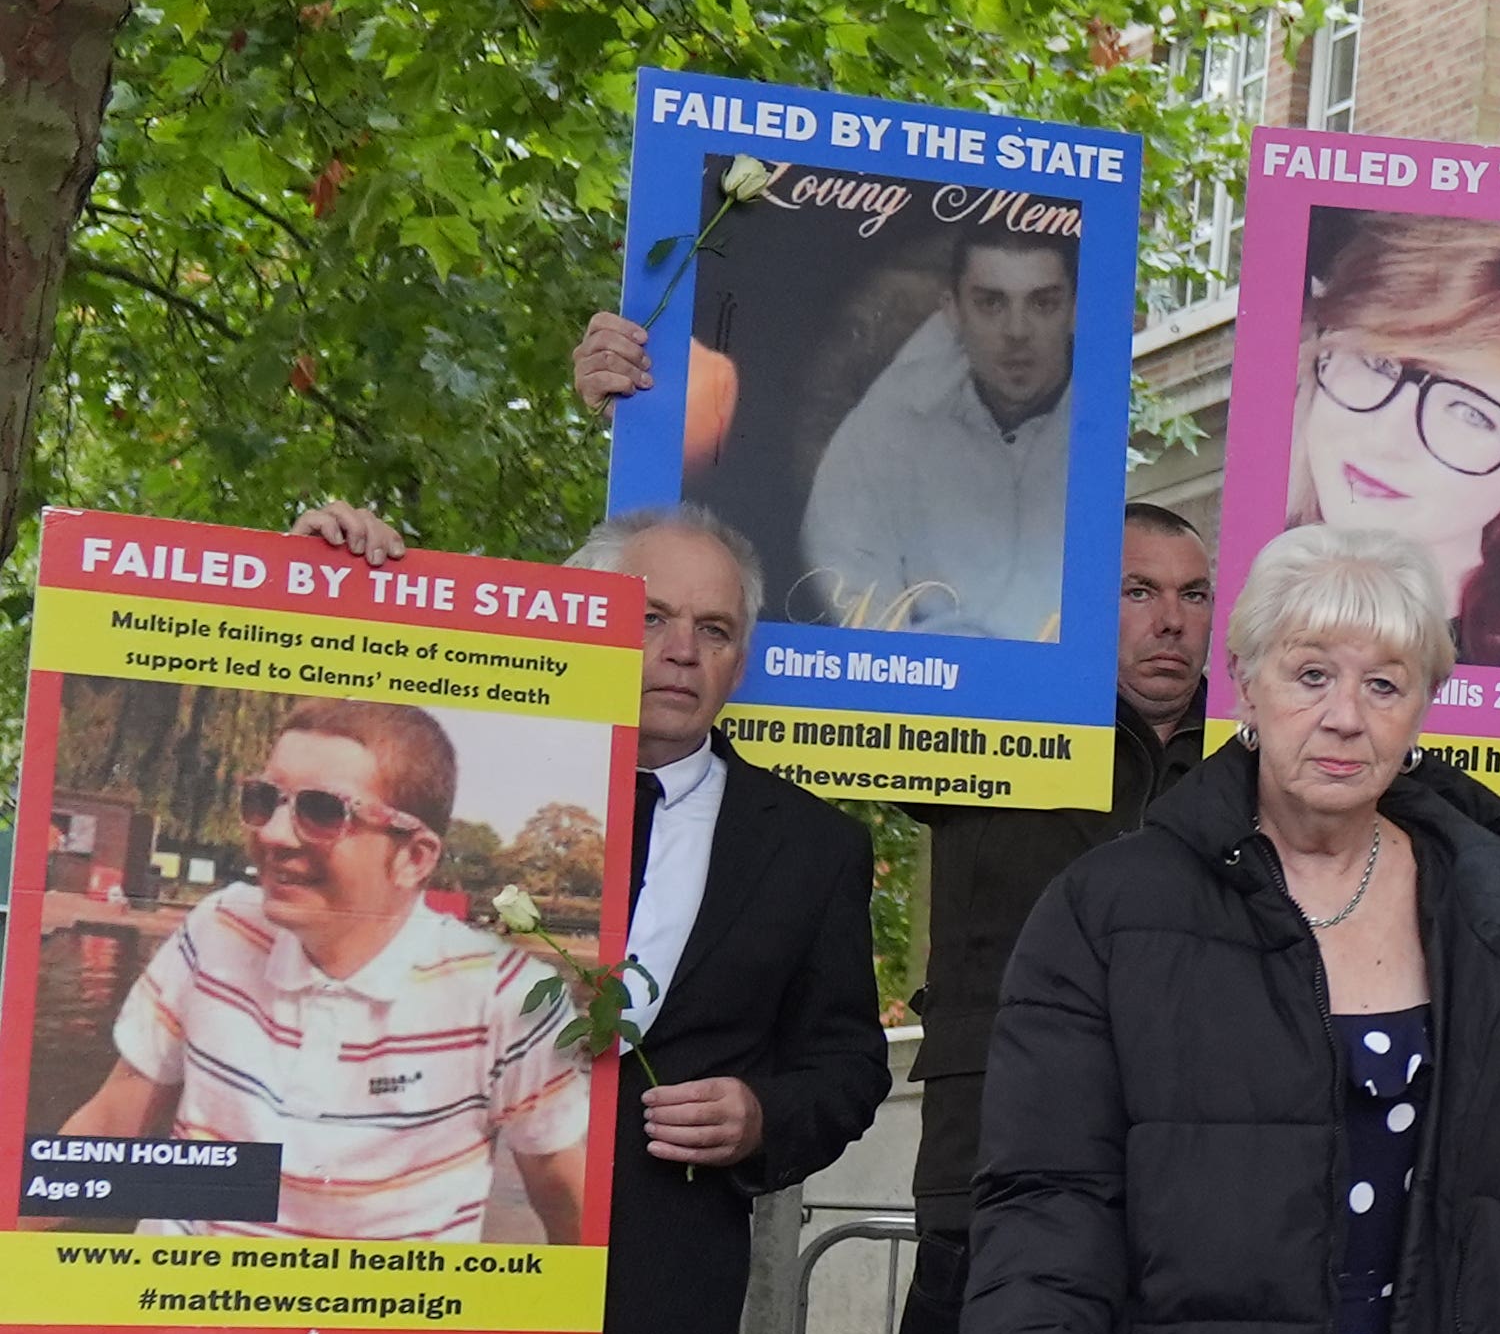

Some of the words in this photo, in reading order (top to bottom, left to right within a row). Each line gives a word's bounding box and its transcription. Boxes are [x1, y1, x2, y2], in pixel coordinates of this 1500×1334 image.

[81, 537, 266, 589] FAILED
[287, 561, 352, 598] BY
[368, 570, 455, 611] THE
[474, 582, 608, 628] STATE
[111, 610, 211, 638] Multiple
[217, 620, 303, 648] failings
[310, 634, 355, 652] and
[361, 635, 409, 657] lack
[415, 642, 438, 660] of
[444, 649, 568, 677] community
[125, 651, 218, 673] support
[225, 656, 261, 677] led
[268, 662, 291, 680] to
[388, 677, 479, 698] needless
[485, 682, 550, 705] death
[765, 646, 841, 679] Chris
[847, 651, 959, 690] McNally
[30, 1139, 125, 1163] GLENN
[130, 1142, 237, 1167] HOLMES
[26, 1175, 80, 1200] Age
[84, 1179, 111, 1198] 19
[138, 1288, 462, 1320] #matthewscampaign
